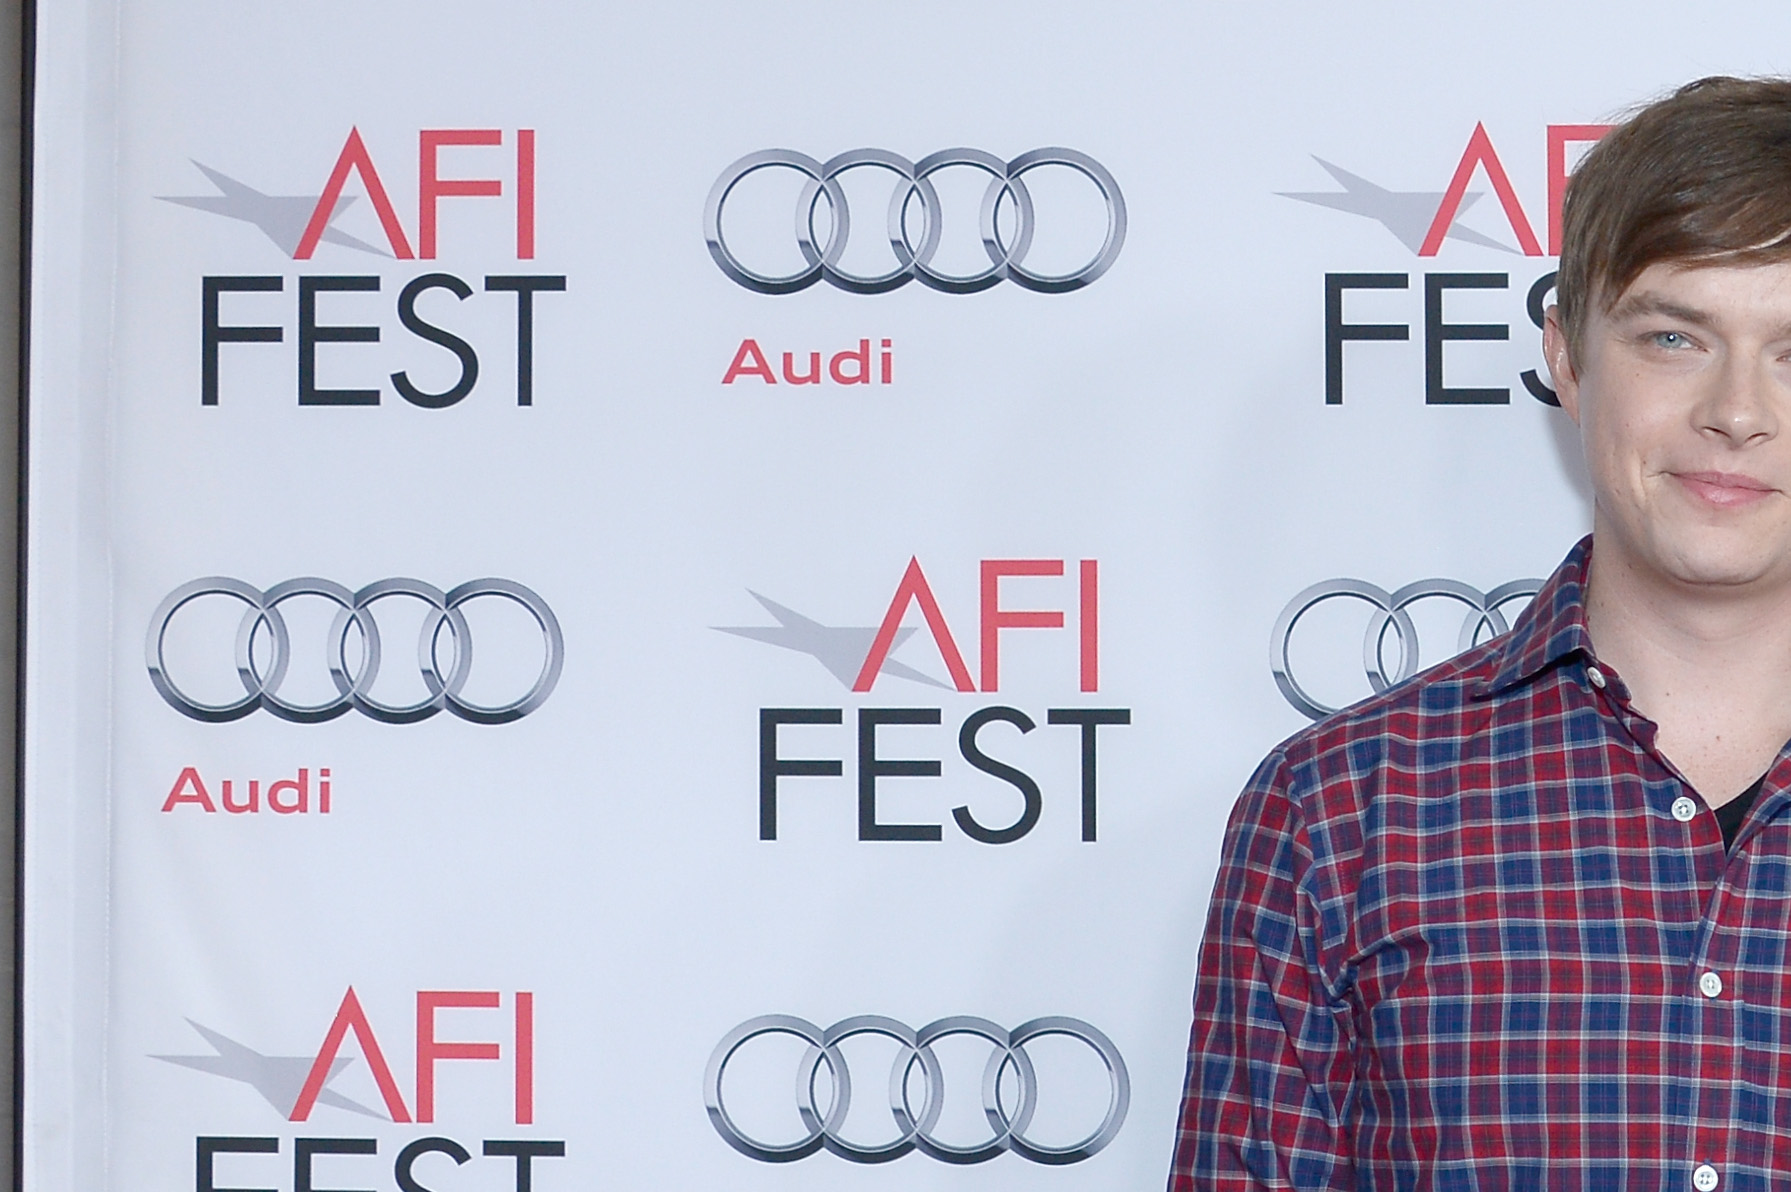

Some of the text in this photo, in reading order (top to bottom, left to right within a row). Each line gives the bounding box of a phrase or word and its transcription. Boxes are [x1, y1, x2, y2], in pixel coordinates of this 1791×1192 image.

[294, 125, 535, 259] AFI
[1418, 120, 1617, 257] AF
[202, 274, 566, 408] FEST
[724, 339, 892, 385] Audi
[1325, 271, 1562, 408] FE
[854, 558, 1098, 692] AFI
[163, 767, 330, 813] Audi
[760, 707, 1130, 844] FEST
[290, 988, 533, 1124] AFI
